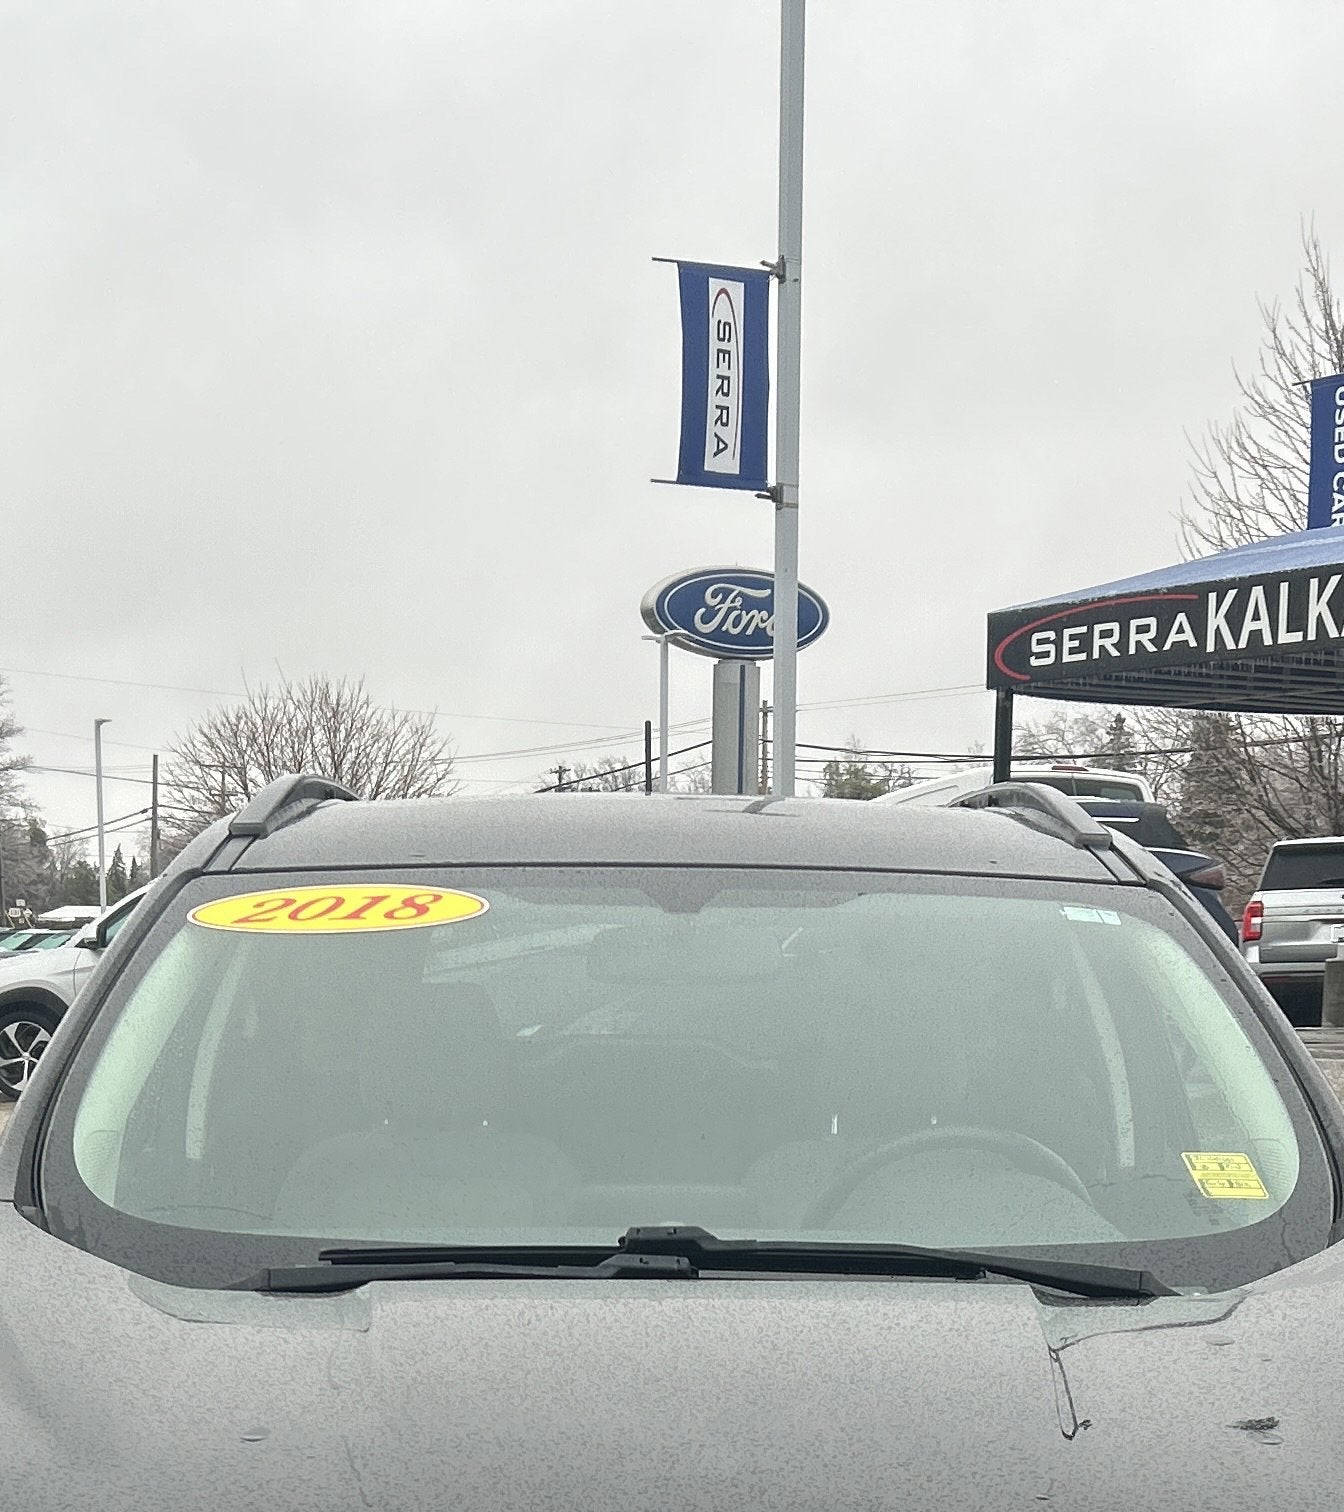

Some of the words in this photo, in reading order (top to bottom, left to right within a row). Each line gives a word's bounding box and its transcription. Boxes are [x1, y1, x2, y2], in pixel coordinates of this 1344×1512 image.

[712, 318, 732, 460] SERRA
[1029, 611, 1198, 667] SERRA
[230, 893, 443, 924] 2018
